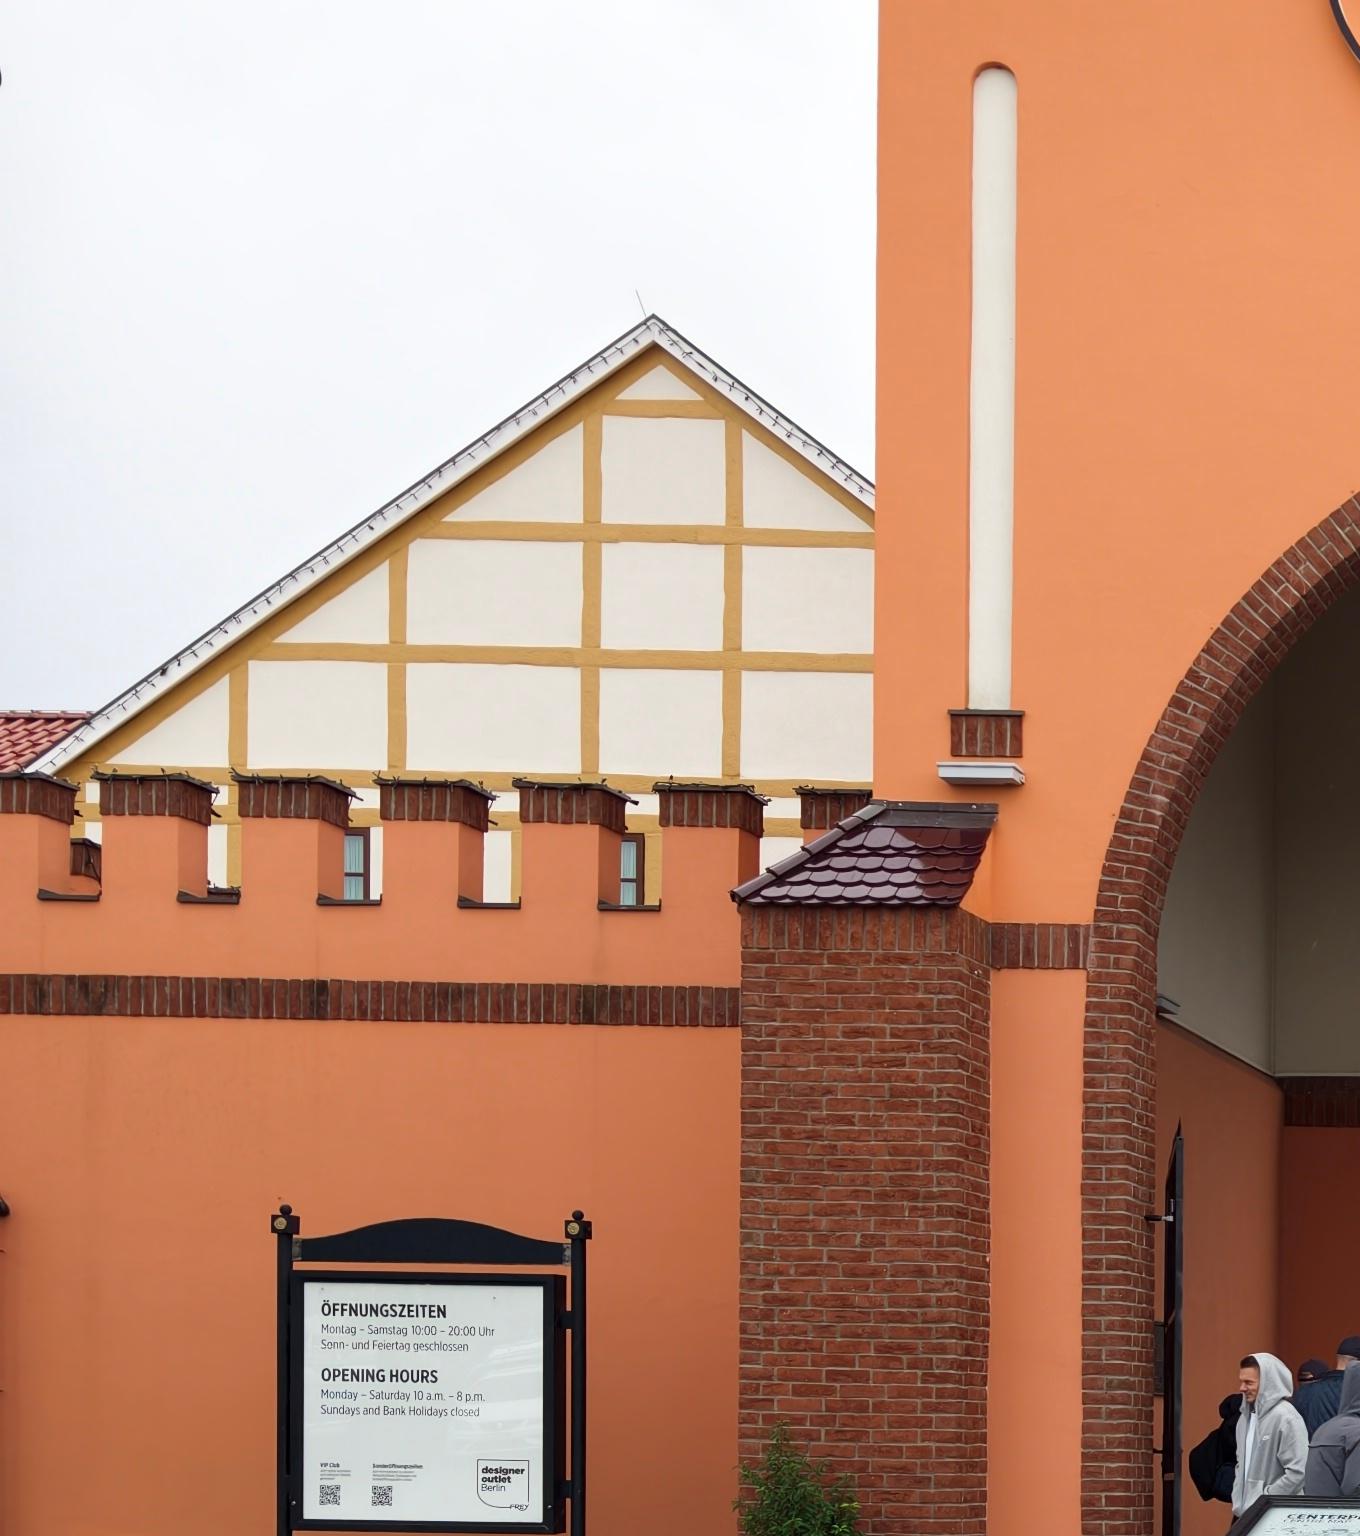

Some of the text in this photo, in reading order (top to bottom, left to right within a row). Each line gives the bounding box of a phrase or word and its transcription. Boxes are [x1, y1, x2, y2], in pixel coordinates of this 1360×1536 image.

[321, 1299, 447, 1319] ÖFFNUNGSZEITEN
[321, 1324, 357, 1336] Montag
[367, 1325, 408, 1337] Samstag
[411, 1325, 437, 1336] 10:00
[448, 1326, 476, 1337] 20:00
[478, 1326, 495, 1337] Uhr
[320, 1339, 469, 1353] Sonn- und Feiertag geschlossen
[321, 1368, 438, 1384] OPENING HOURS
[320, 1389, 358, 1401] Monday
[369, 1390, 411, 1402] Saturday
[413, 1390, 424, 1401] 10
[426, 1392, 446, 1401] a.m.
[456, 1391, 463, 1402] 8
[465, 1393, 486, 1403] p.m.
[320, 1404, 480, 1418] Sundays and Bank Holidays closed
[481, 1466, 525, 1476] designer
[481, 1475, 512, 1484] outlet
[481, 1483, 506, 1492] Berlin
